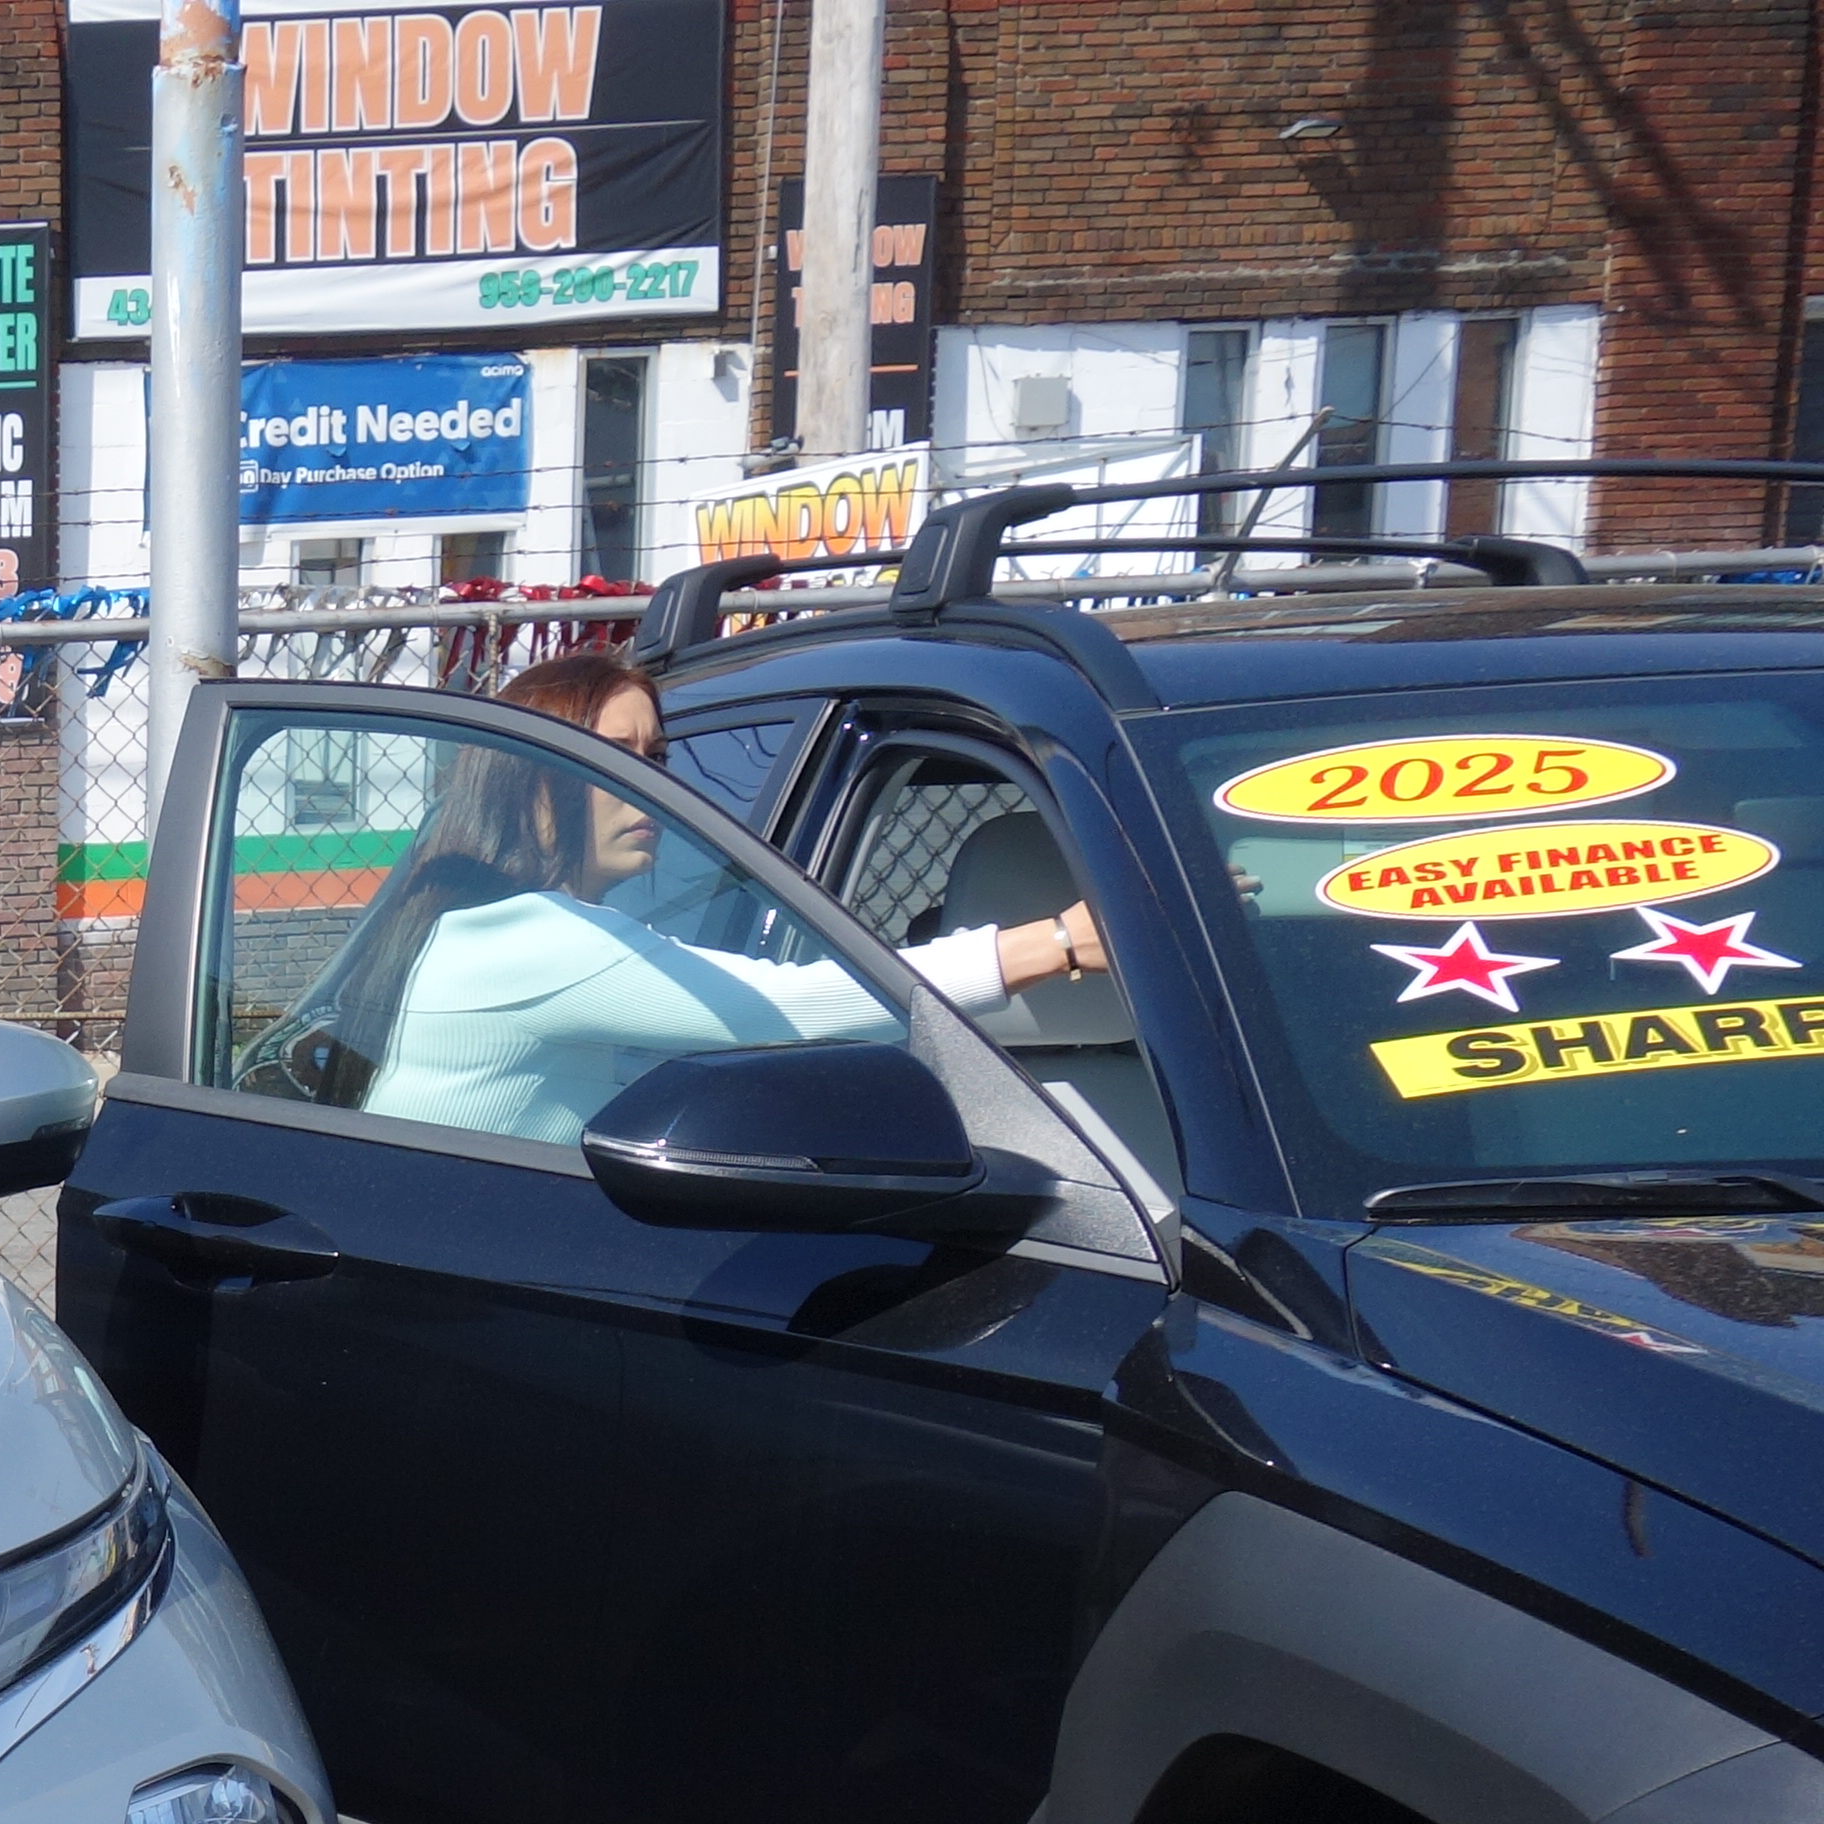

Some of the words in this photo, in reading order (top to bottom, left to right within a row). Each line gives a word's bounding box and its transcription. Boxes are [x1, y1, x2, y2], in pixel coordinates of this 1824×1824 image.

[107, 288, 152, 326] 43
[479, 260, 699, 309] 959-200-2217
[356, 398, 522, 443] Needed
[260, 468, 292, 489] Day
[295, 465, 377, 484] Purchase
[381, 462, 444, 485] Option
[695, 458, 918, 564] WINDOW
[1306, 748, 1590, 811] 2025
[1348, 857, 1482, 892] EASY
[1499, 833, 1728, 873] FINANCE
[1410, 860, 1700, 910] AVAILABLE
